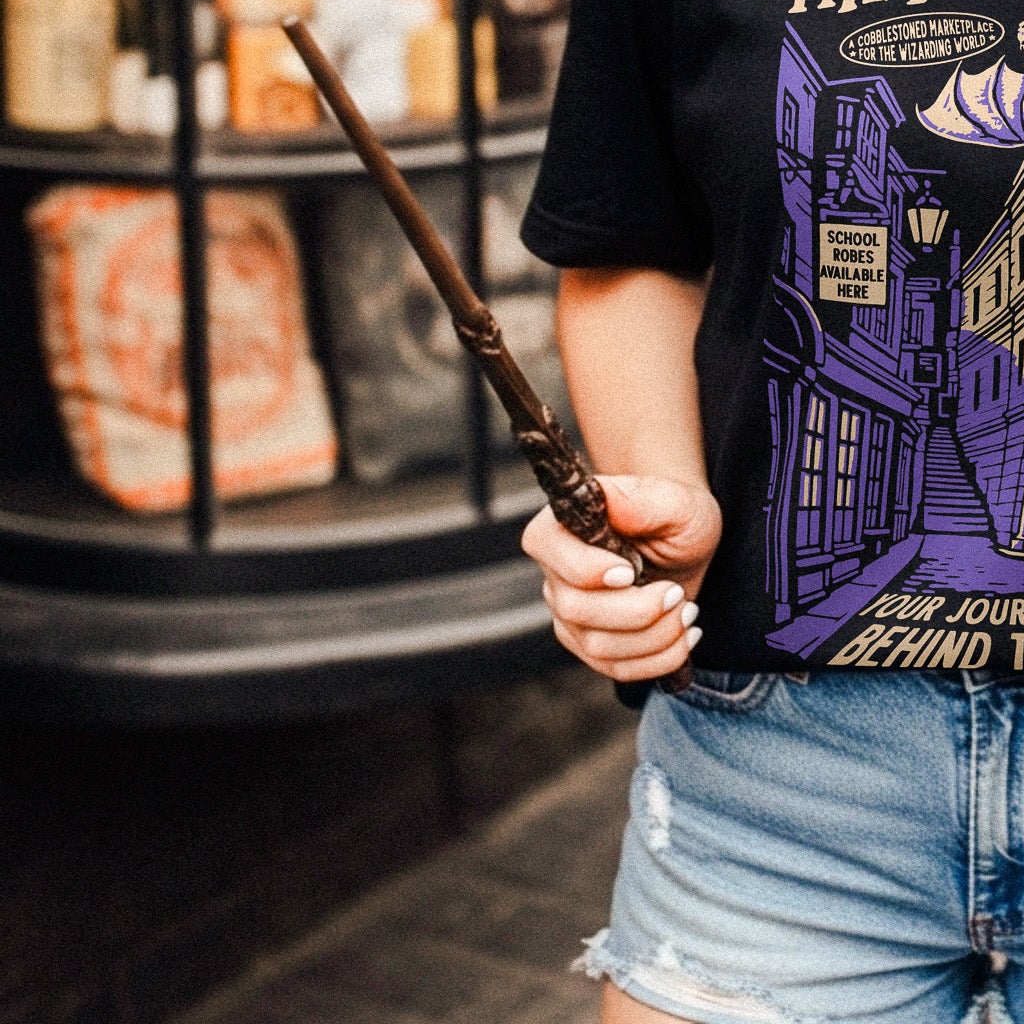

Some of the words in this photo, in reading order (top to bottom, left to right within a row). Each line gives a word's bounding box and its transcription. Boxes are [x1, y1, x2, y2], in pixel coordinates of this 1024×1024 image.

[849, 40, 855, 49] A
[858, 21, 927, 47] COBBLESTONED
[929, 19, 995, 37] MARKETPLACE
[858, 48, 876, 60] FOR
[879, 45, 897, 61] THE
[899, 41, 951, 61] WIZARDING
[954, 35, 986, 53] WORLD
[827, 230, 880, 246] SCHOOL
[833, 248, 874, 264] ROBES
[820, 265, 885, 282] AVAILABLE
[837, 283, 869, 299] HERE
[859, 593, 945, 621] YOUR
[827, 624, 992, 668] BEHIND
